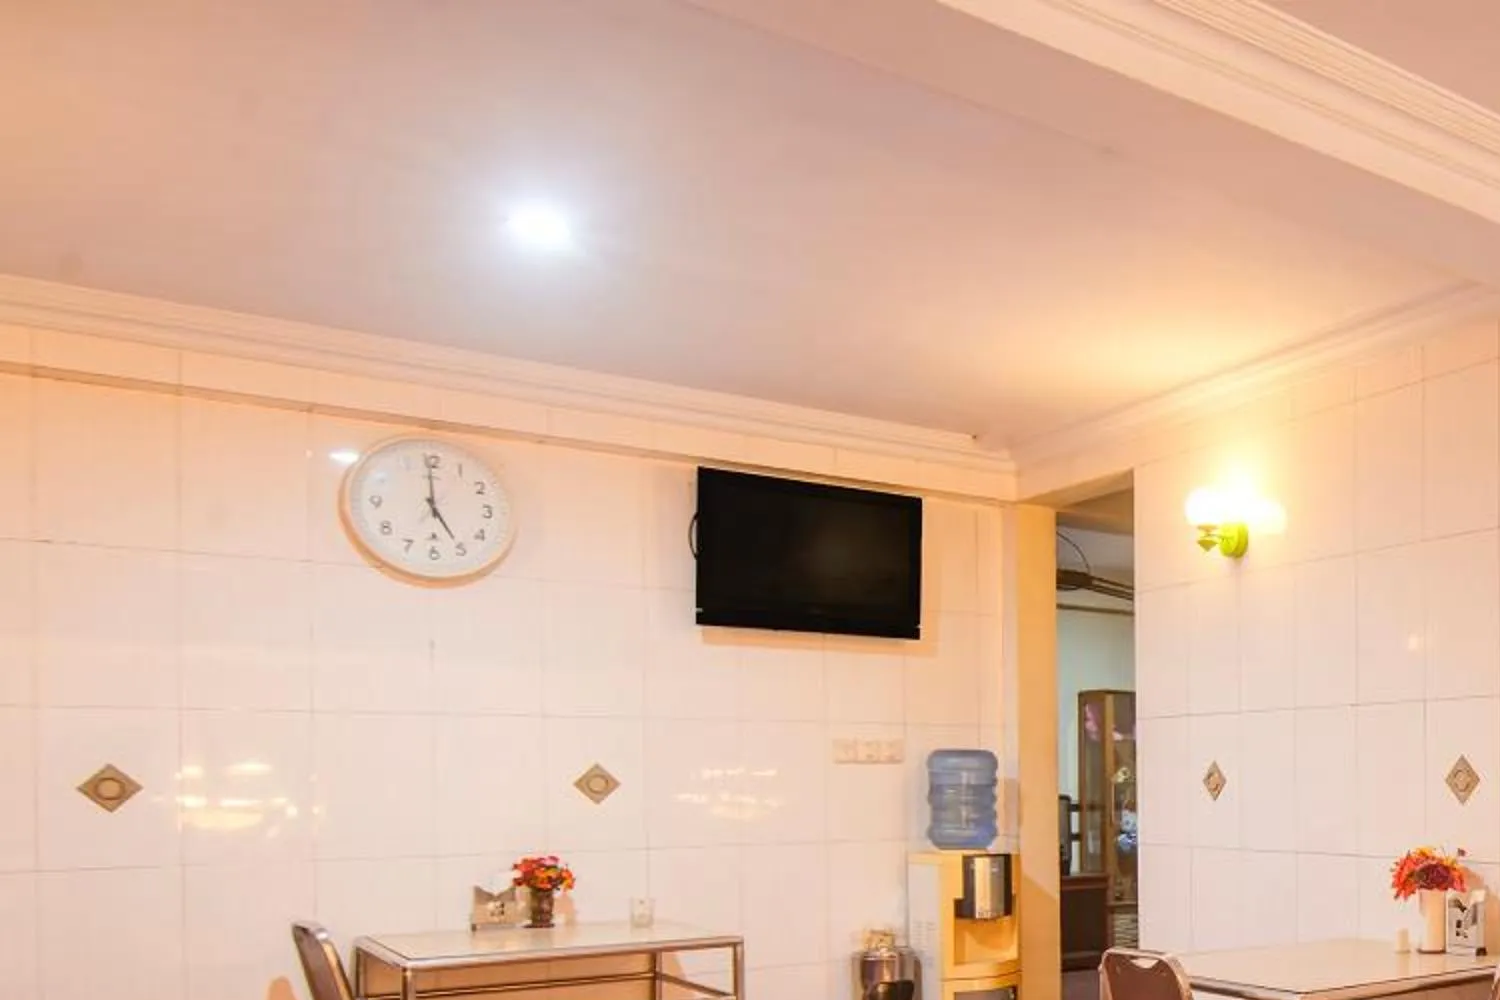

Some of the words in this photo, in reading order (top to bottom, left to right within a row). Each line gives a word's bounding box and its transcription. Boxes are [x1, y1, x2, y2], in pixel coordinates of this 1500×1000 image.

[474, 481, 486, 495] 2
[369, 495, 382, 509] 9
[482, 504, 493, 519] 3
[380, 521, 392, 535] 8
[474, 529, 486, 542] 4
[402, 539, 414, 553] 7
[428, 546, 441, 560] 6
[455, 542, 467, 557] 5
